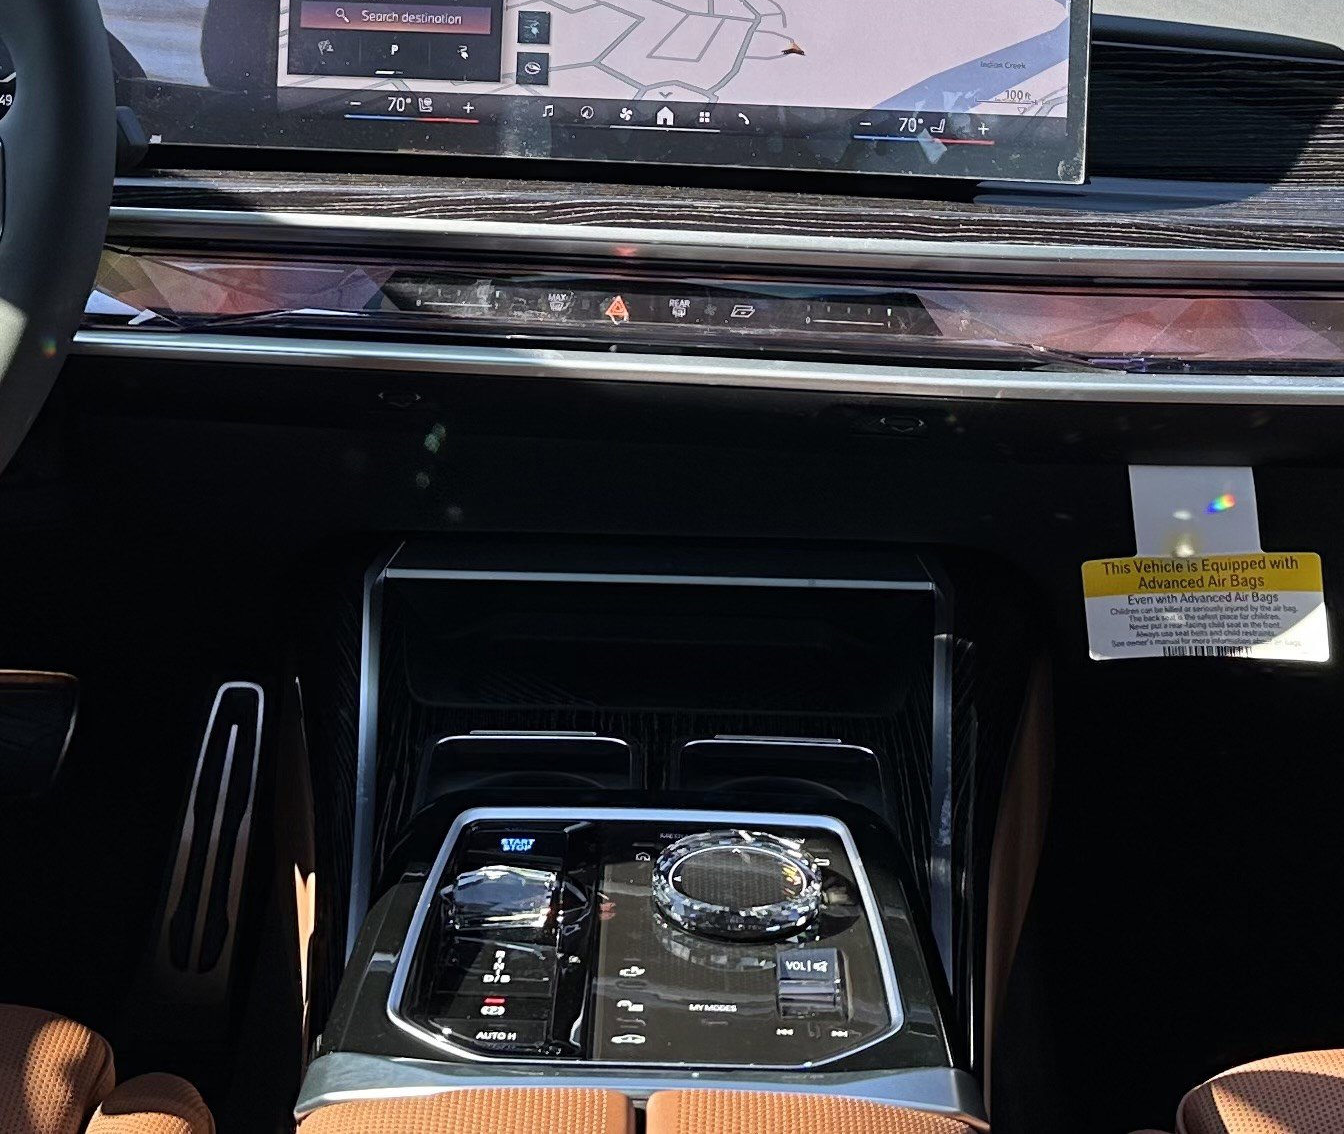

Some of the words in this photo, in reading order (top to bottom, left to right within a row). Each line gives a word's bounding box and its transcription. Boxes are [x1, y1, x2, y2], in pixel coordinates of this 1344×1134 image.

[361, 9, 399, 23] Search
[401, 10, 463, 26] destination
[1005, 89, 1023, 101] 100
[1024, 92, 1032, 101] ft
[387, 96, 412, 112] 70°
[898, 117, 924, 133] 70°
[548, 292, 567, 301] MAX
[669, 298, 690, 307] REAR
[1102, 561, 1131, 575] This
[1134, 559, 1183, 574] Vehicle
[1187, 558, 1198, 572] is
[1202, 556, 1267, 573] Equipped
[1269, 554, 1299, 570] with
[1138, 575, 1205, 589] Advanced
[1207, 574, 1227, 588] Air
[1230, 574, 1265, 590] Bags
[1127, 594, 1154, 605] Even
[1156, 593, 1178, 604] with
[1180, 592, 1232, 604] Advanced
[1234, 592, 1249, 603] Air
[1251, 591, 1279, 604] Bags
[1110, 607, 1140, 616] Children
[1141, 607, 1153, 615] can
[1154, 606, 1164, 614] be
[1250, 604, 1259, 613] by
[1260, 604, 1272, 612] the
[1273, 604, 1282, 612] air
[1129, 614, 1143, 623] The
[1143, 613, 1160, 622] back
[1239, 612, 1249, 620] for
[500, 838, 536, 846] START
[502, 844, 532, 852] STOP
[785, 960, 807, 972] VOL
[689, 1003, 705, 1012] MY
[706, 1004, 738, 1013] MODES
[476, 1031, 506, 1041] AUTO
[508, 1031, 517, 1041] H
